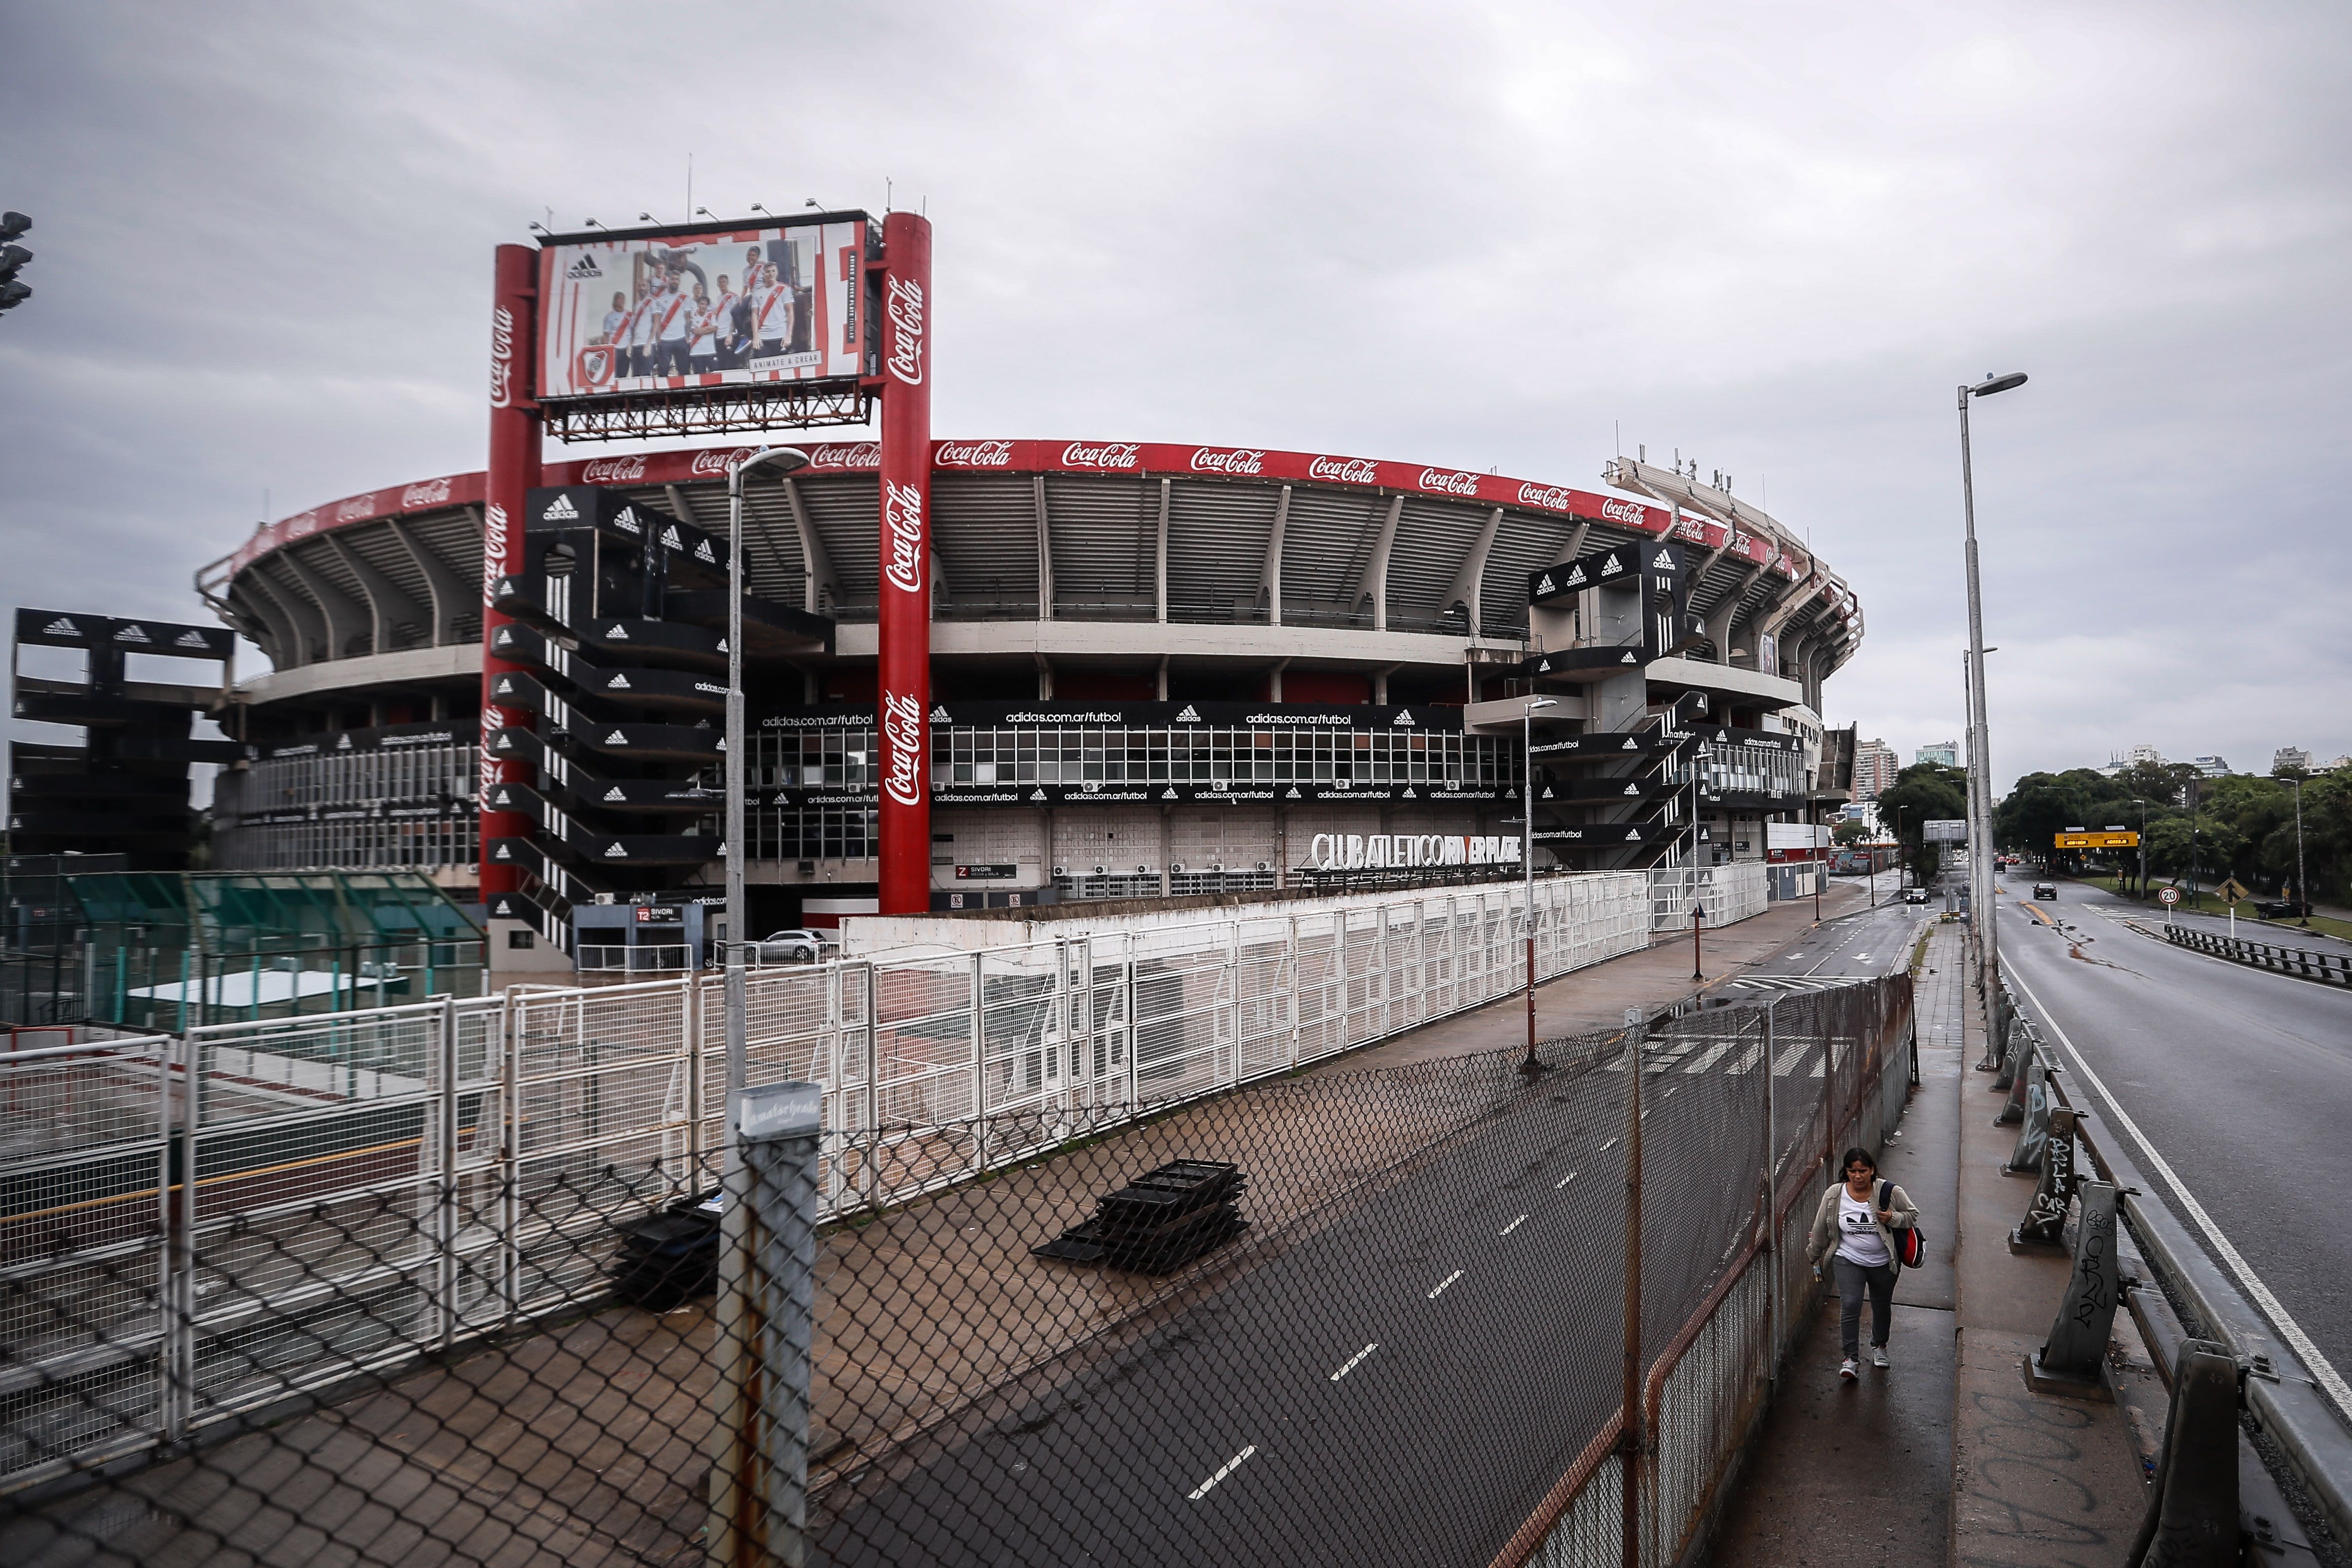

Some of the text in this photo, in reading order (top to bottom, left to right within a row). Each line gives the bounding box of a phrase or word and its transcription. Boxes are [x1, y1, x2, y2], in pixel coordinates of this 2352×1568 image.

[888, 273, 923, 385] Coca-Cola
[754, 358, 784, 369] ANIMATE
[935, 440, 1015, 466] Coca-Cola
[1062, 441, 1141, 468] Coca-Cola
[1190, 447, 1266, 474] Coca-Cola
[583, 456, 646, 484] Coca-Cola
[1308, 456, 1379, 484] Coca-Cola
[1418, 467, 1481, 496] Coca-Cola
[1517, 482, 1571, 511] Coca-Cola
[543, 509, 580, 521] adidas
[1601, 498, 1646, 525] Coca-Cola
[613, 516, 640, 535] adidas
[660, 535, 684, 551] adidas
[886, 479, 921, 593] Coca-Cola
[694, 549, 716, 564] adidas
[1601, 564, 1623, 577] adidas
[1653, 561, 1676, 570] adidas
[1567, 576, 1587, 587] adidas
[1536, 585, 1555, 595] adidas
[762, 714, 873, 727] adidas.com.ar/futbol
[1006, 712, 1121, 723] adidas.com.ar/futbol
[1246, 714, 1351, 725] adidas.com.ar/futbol
[885, 689, 920, 805] Coca-Cola
[935, 793, 1018, 802] adidas.com.ar/futbol
[1065, 792, 1147, 800] adidas.com.ar/futbol
[1195, 791, 1274, 800] adidas.com.ar/futbol
[1318, 791, 1390, 799] adidas.com.ar/futbol
[1431, 791, 1496, 800] adidas.com.ar/futbol
[1311, 833, 1365, 871] CLUB
[2163, 891, 2175, 900] 20
